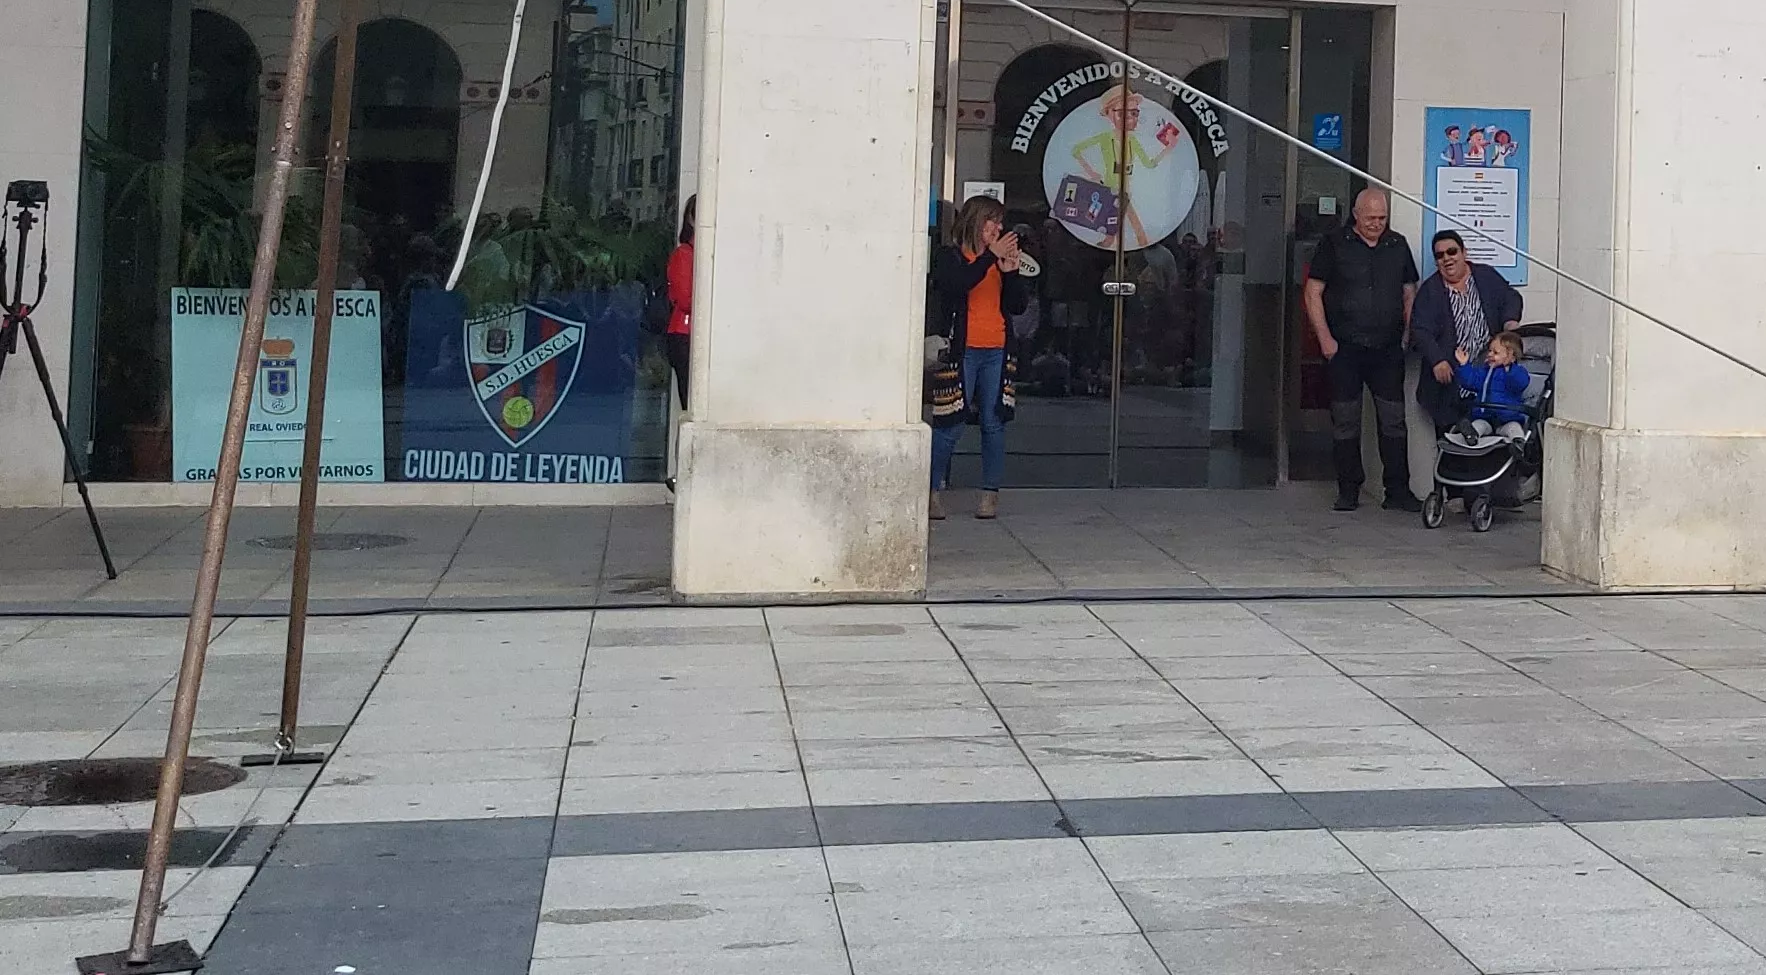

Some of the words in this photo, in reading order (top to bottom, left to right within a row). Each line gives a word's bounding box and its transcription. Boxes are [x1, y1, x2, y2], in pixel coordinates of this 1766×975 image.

[1010, 61, 1141, 154] BIENVENIDOS
[176, 295, 291, 316] BIENVENOS
[295, 297, 307, 317] A
[311, 297, 377, 317] ESCA
[485, 372, 514, 394] S.D.
[514, 333, 573, 376] HUESCA
[249, 424, 273, 432] REAL
[275, 423, 307, 432] OVIED
[255, 467, 286, 480] POR
[288, 464, 374, 480] VITARNOS
[404, 449, 485, 480] CIUDAD
[491, 452, 520, 482] DE
[524, 454, 624, 484] LEYENDA
